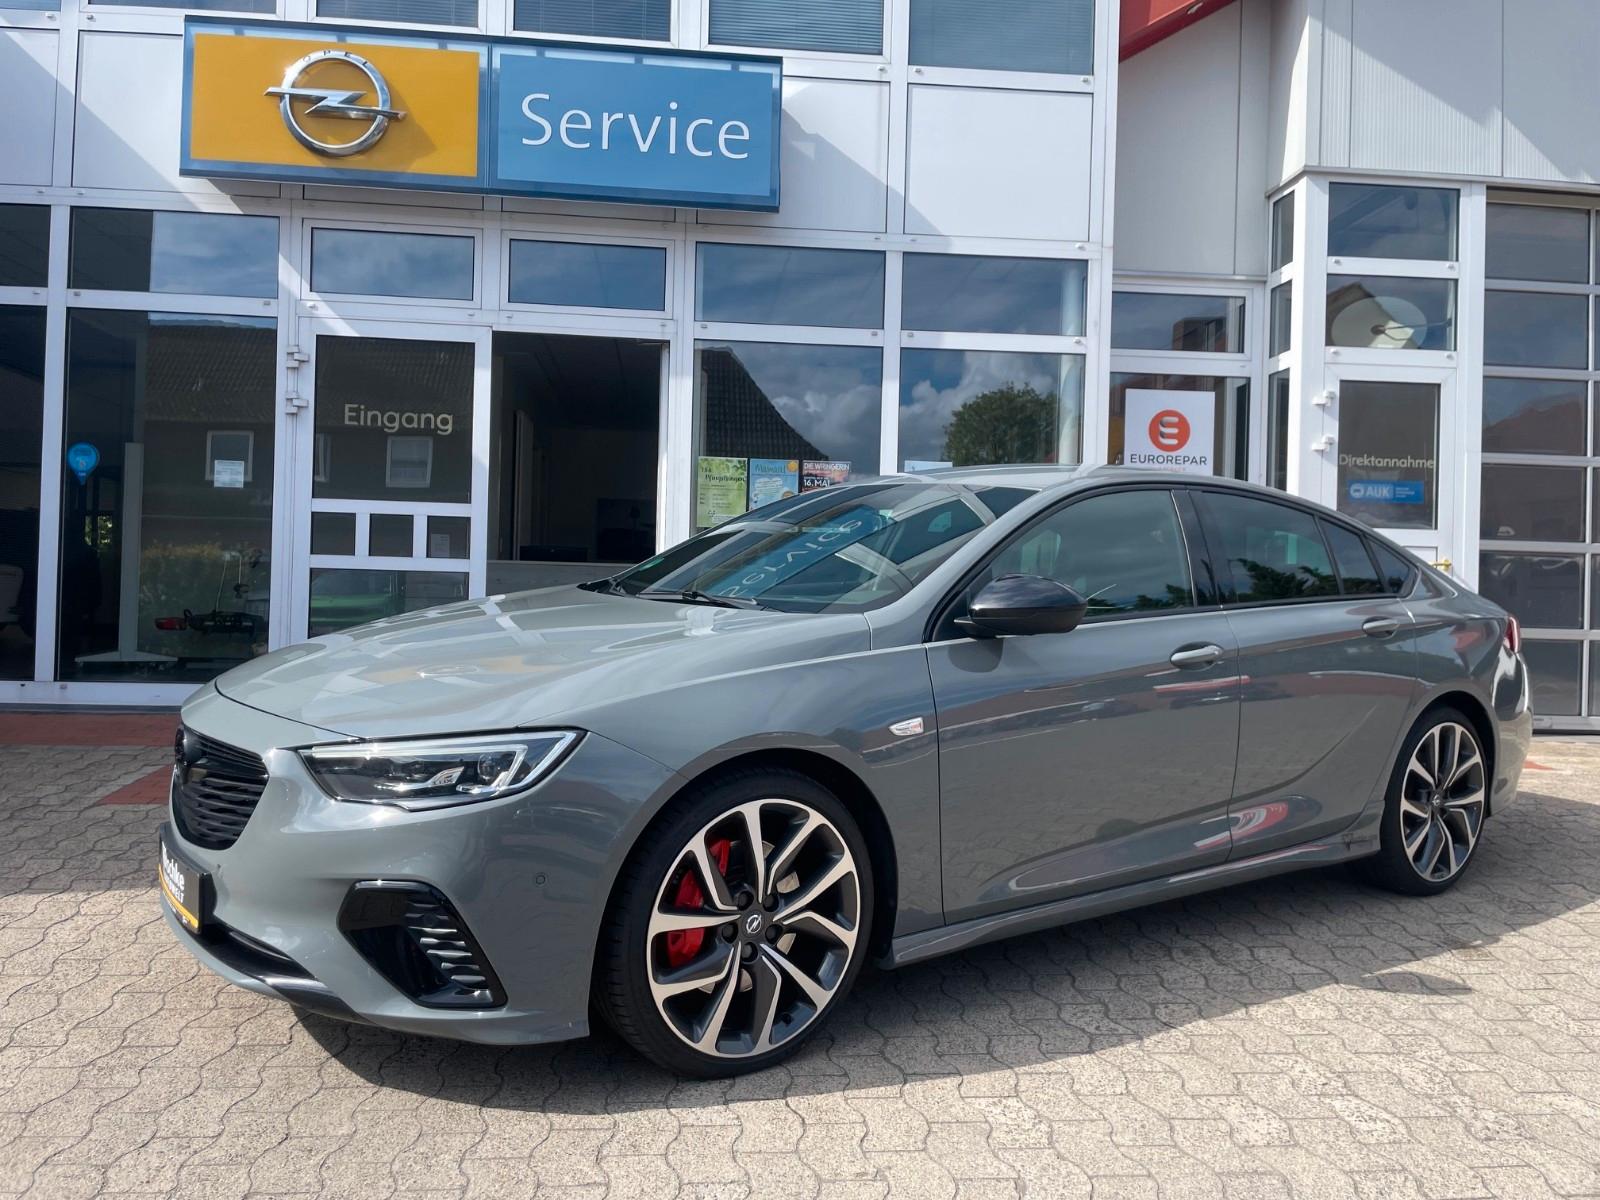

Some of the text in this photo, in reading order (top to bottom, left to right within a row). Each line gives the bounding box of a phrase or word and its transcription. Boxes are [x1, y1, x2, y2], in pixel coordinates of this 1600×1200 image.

[520, 92, 751, 160] Service
[344, 403, 454, 436] Eingang
[1130, 453, 1208, 466] EUROREPAR
[1339, 453, 1435, 468] Direktannahme
[803, 479, 831, 488] 16. MAI
